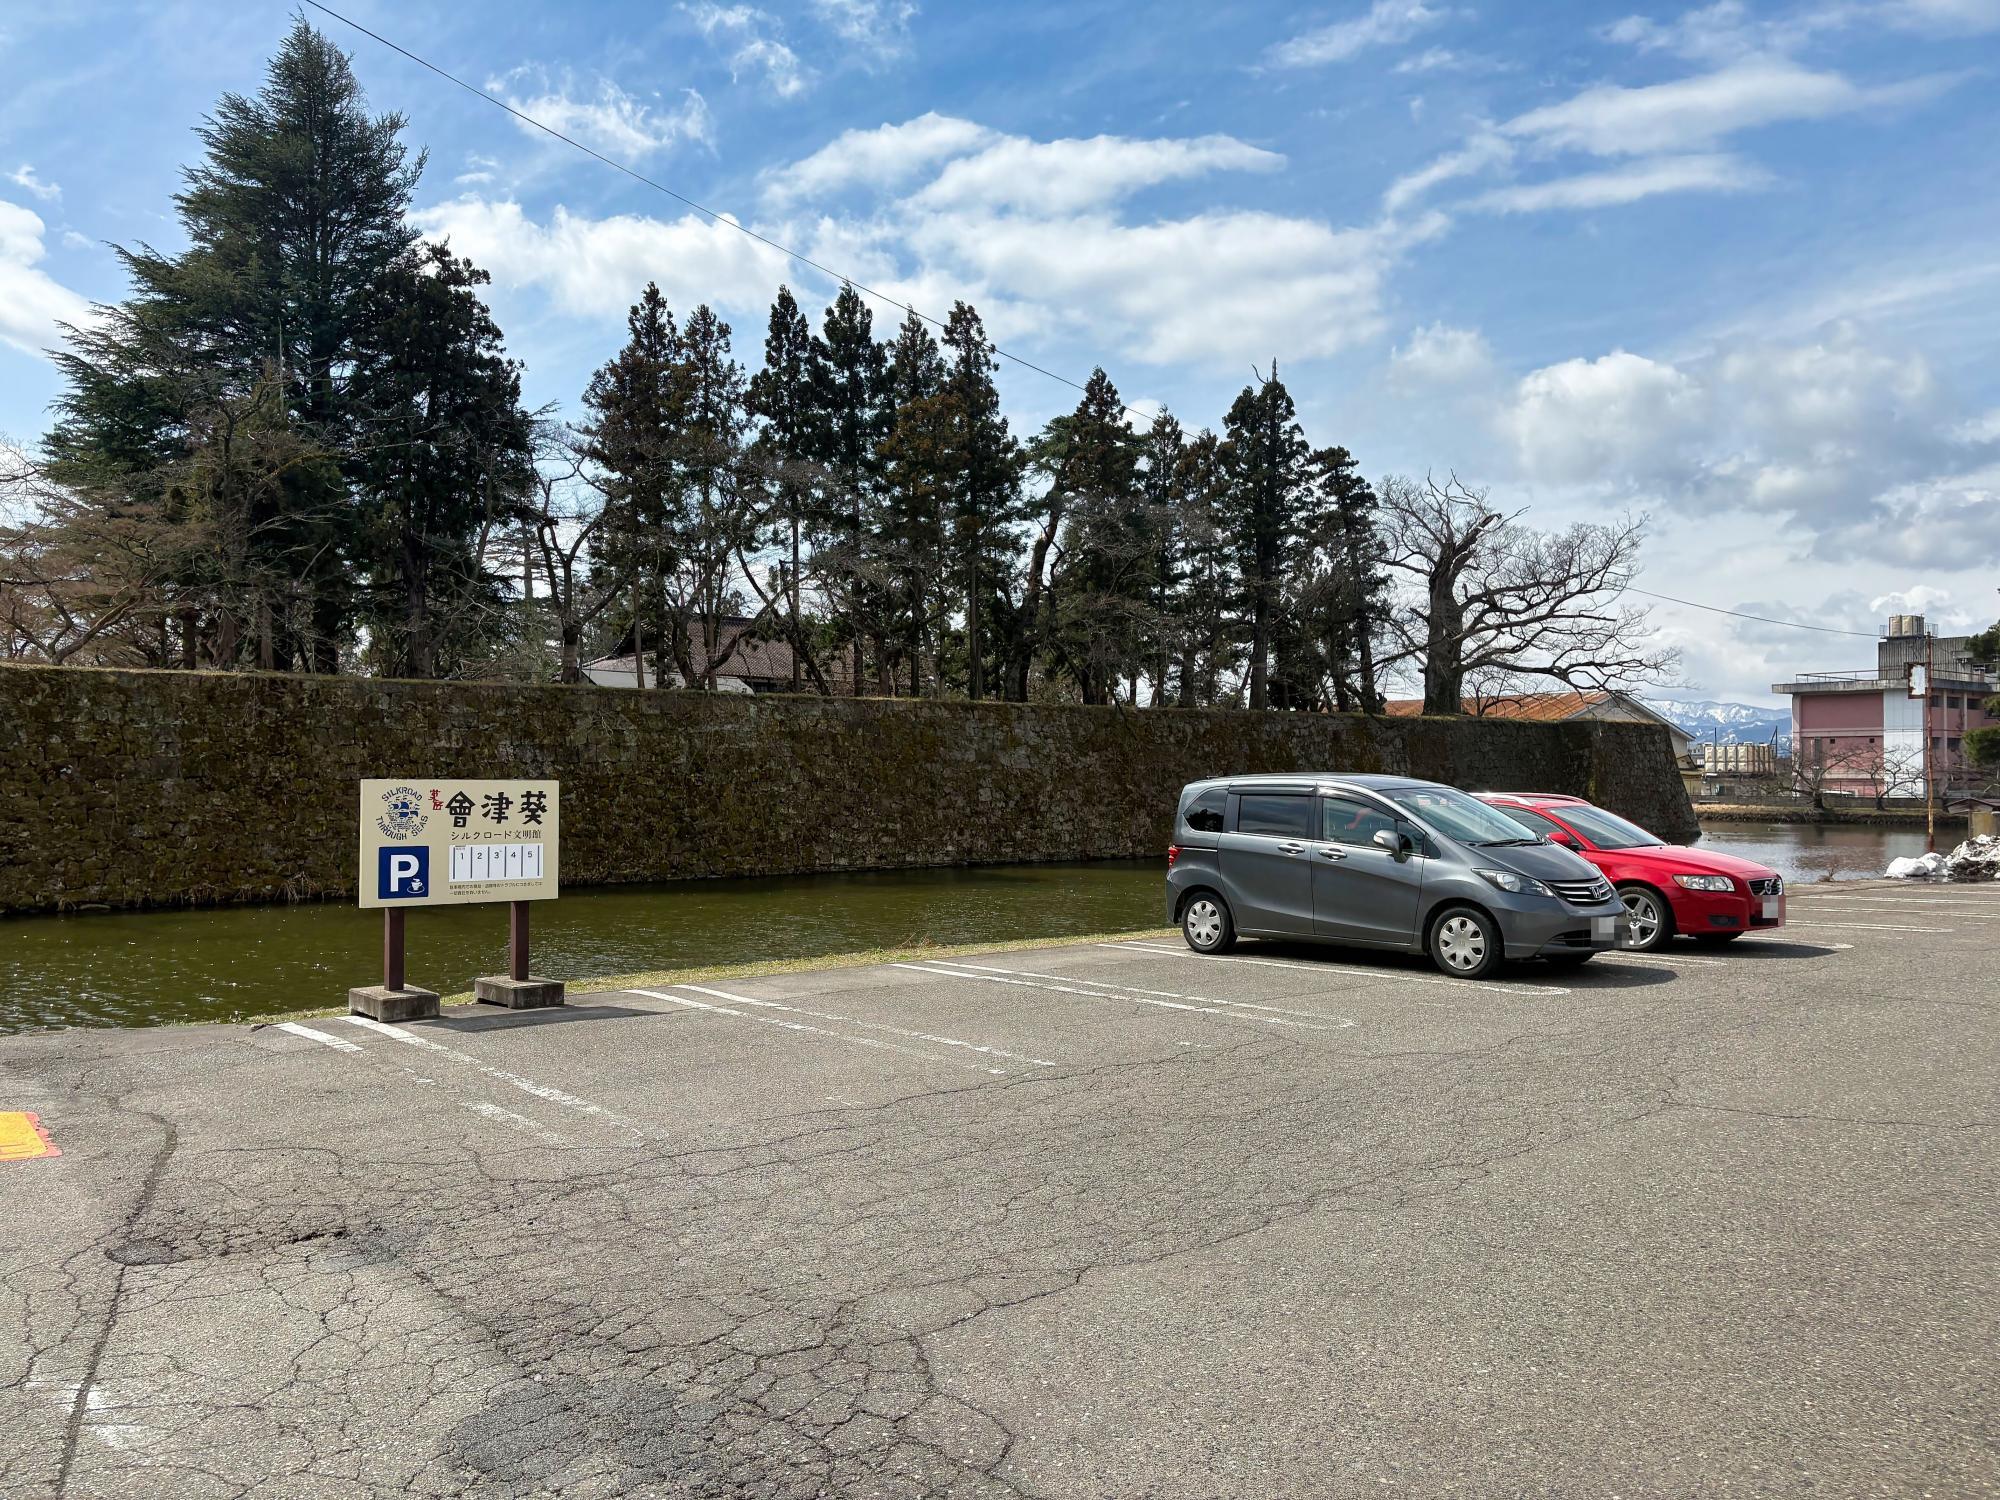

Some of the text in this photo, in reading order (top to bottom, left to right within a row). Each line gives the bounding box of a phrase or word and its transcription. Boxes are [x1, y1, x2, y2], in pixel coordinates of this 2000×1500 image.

[381, 786, 423, 802] SILKROAD
[445, 790, 548, 828] 會津葵
[375, 815, 429, 841] THROUGH SEAS
[451, 829, 542, 840] シルクロード文明館
[477, 852, 483, 860] 2
[494, 851, 500, 859] 3
[510, 851, 516, 859] 4
[527, 850, 533, 858] 5
[390, 854, 420, 892] P
